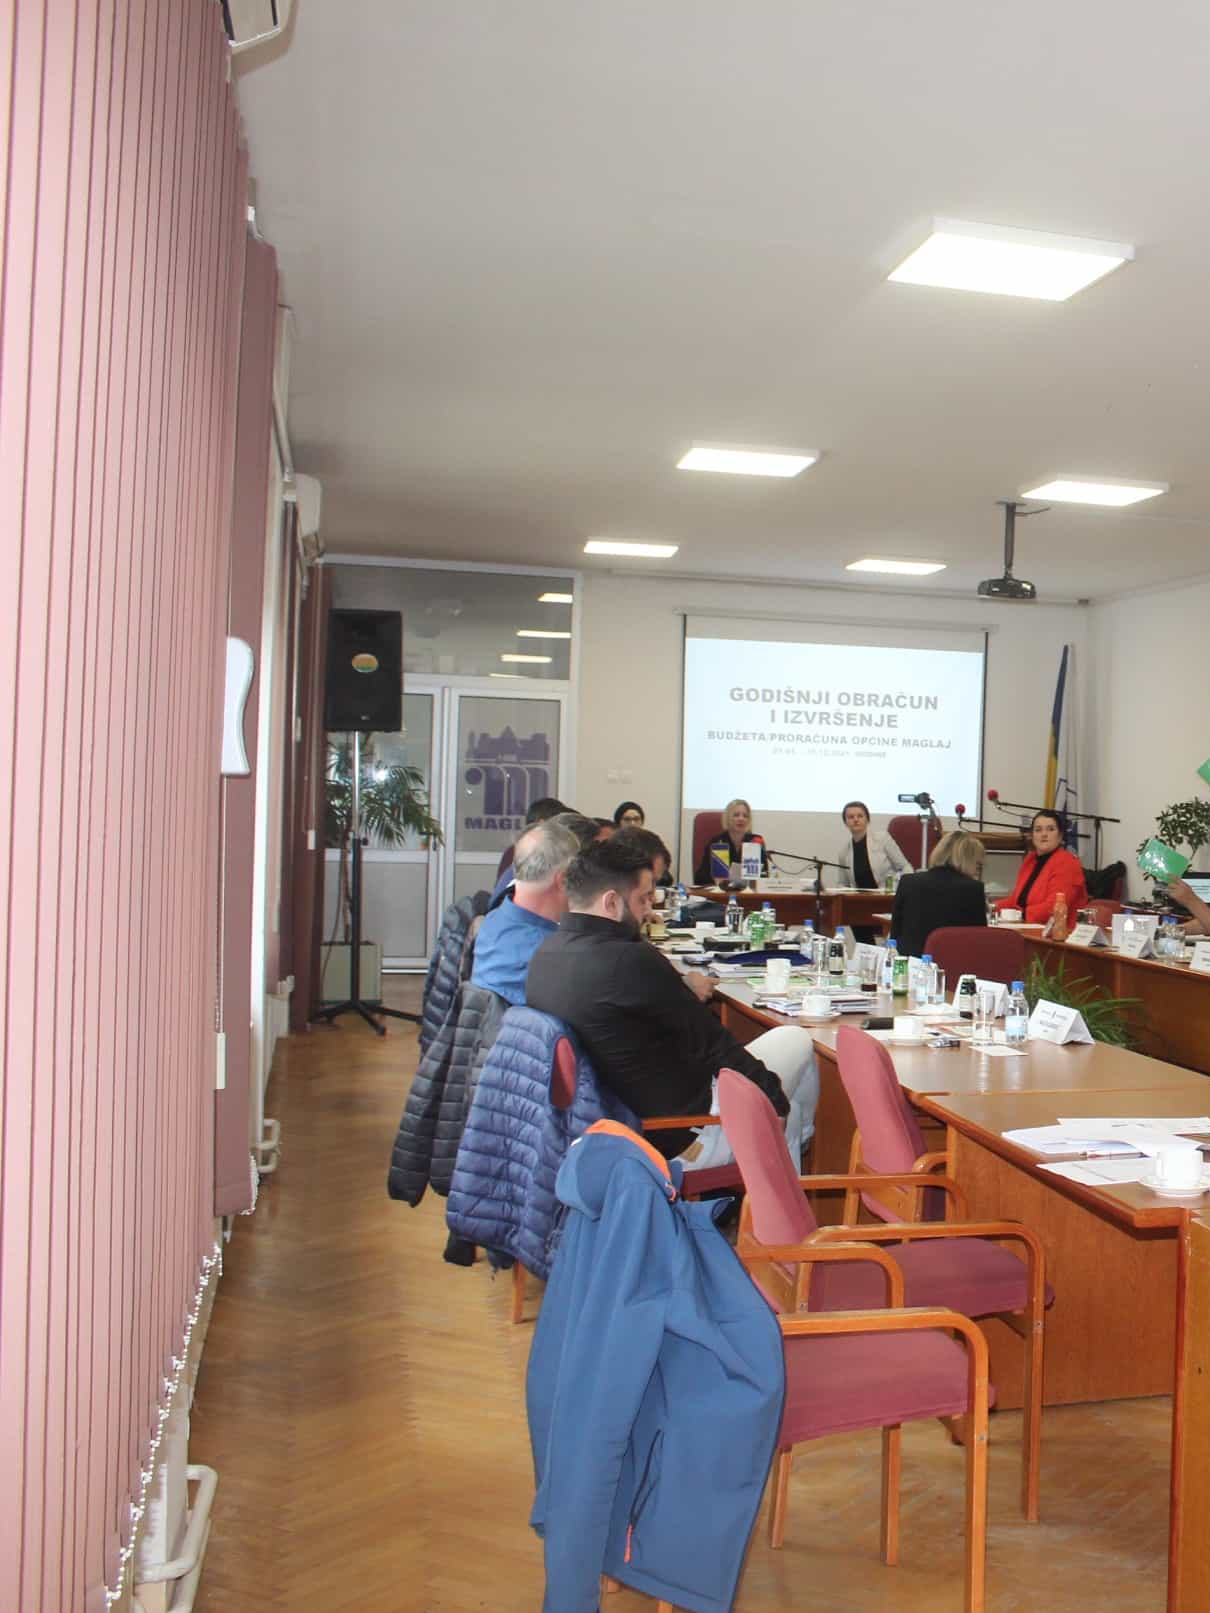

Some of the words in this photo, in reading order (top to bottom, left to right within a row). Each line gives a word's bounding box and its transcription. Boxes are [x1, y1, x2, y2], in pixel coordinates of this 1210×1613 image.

[729, 685, 830, 705] GODIŠNJI
[837, 691, 938, 711] OBRAČUN
[770, 708, 776, 724] I
[783, 708, 899, 729] IZVRŠENJE
[901, 737, 952, 750] MAGLAJ
[463, 816, 523, 831] MAGL
